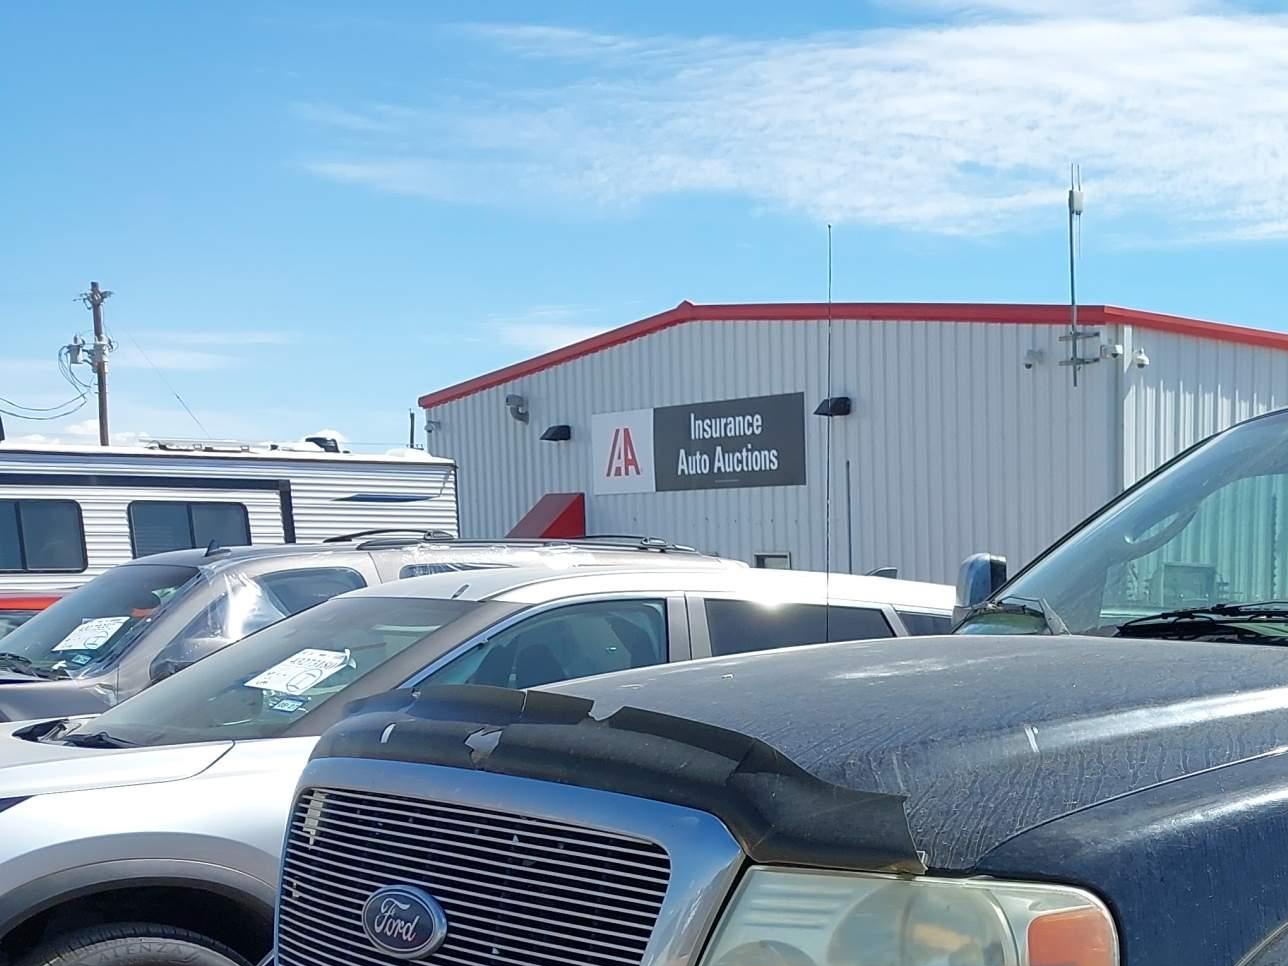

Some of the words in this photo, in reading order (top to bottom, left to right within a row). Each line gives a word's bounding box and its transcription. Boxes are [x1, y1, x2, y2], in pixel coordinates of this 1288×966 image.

[690, 412, 763, 441] Insurance
[677, 448, 711, 477] Auto
[713, 444, 779, 474] Auctions
[374, 897, 421, 942] Ford
